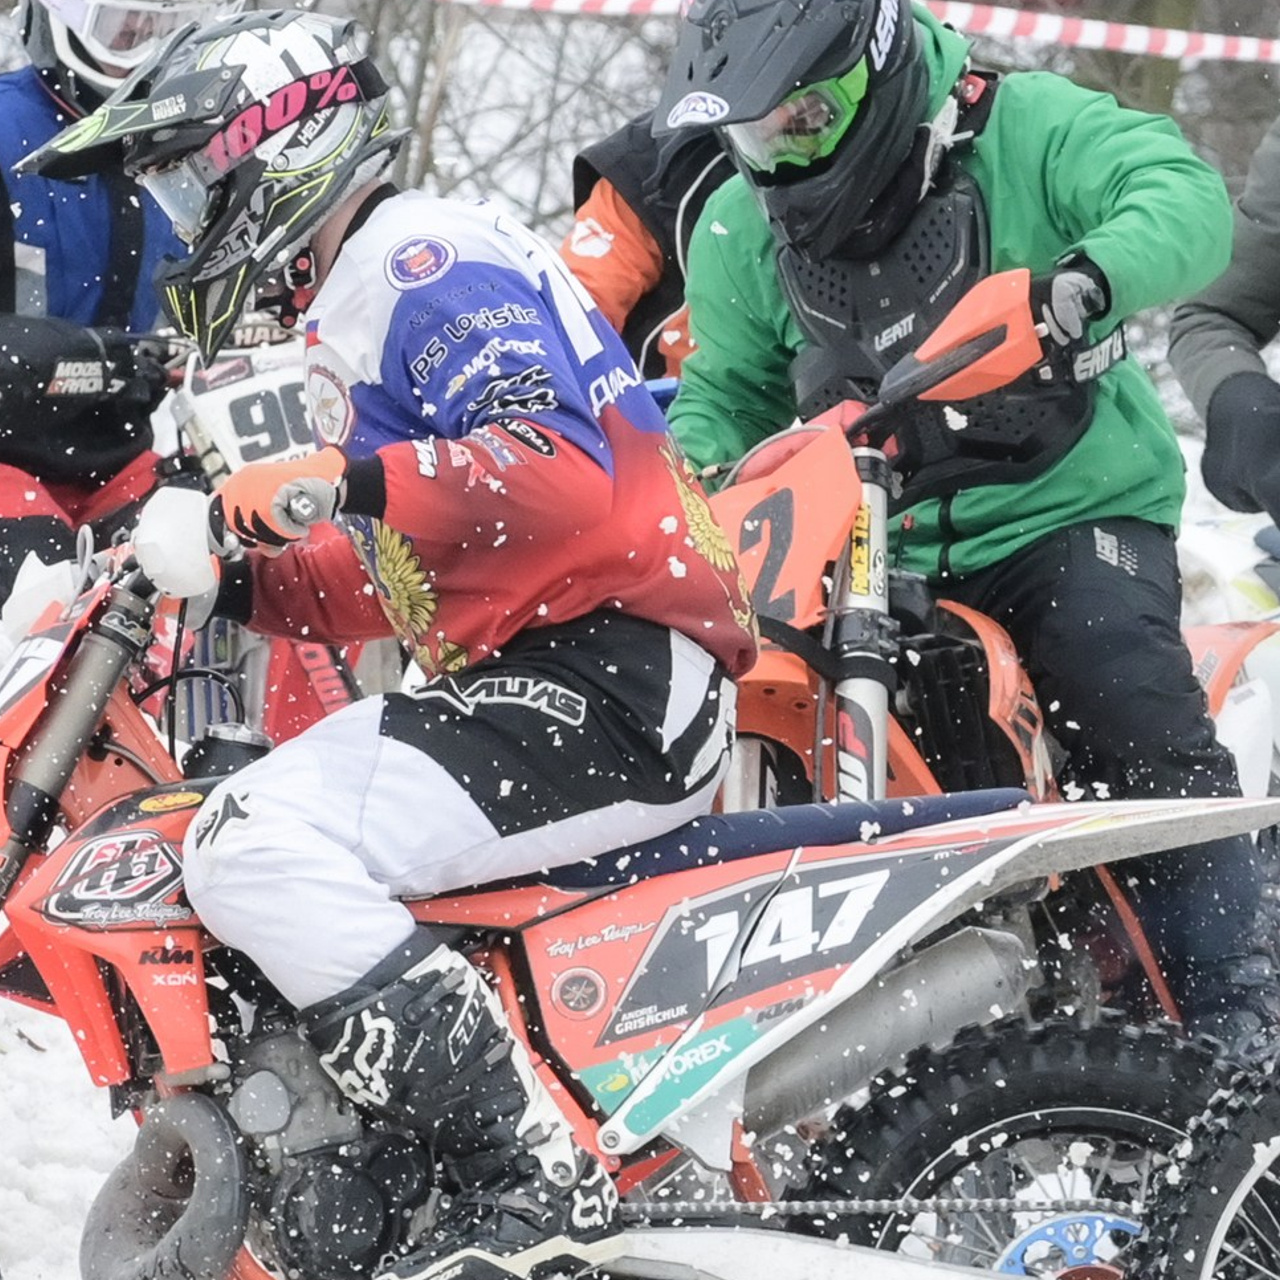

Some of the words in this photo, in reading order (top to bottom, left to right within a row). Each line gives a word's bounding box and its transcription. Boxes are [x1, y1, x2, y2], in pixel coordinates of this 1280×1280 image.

[152, 102, 187, 121] HUSKY
[204, 65, 359, 171] 100%
[297, 105, 334, 146] HELM
[874, 313, 916, 352] LEATT
[55, 361, 117, 377] MOOS
[410, 336, 448, 383] PS
[1073, 335, 1111, 383] EATT
[410, 431, 438, 479] TM
[738, 487, 796, 621] 2
[82, 903, 108, 927] Troy
[111, 902, 133, 921] Lee
[135, 902, 190, 927] Designs
[694, 868, 891, 992] 147
[138, 946, 194, 965] KTM
[546, 937, 576, 959] Troy
[577, 935, 602, 950] Lee
[601, 921, 656, 942] Designs
[630, 1033, 733, 1085] MTOREX
